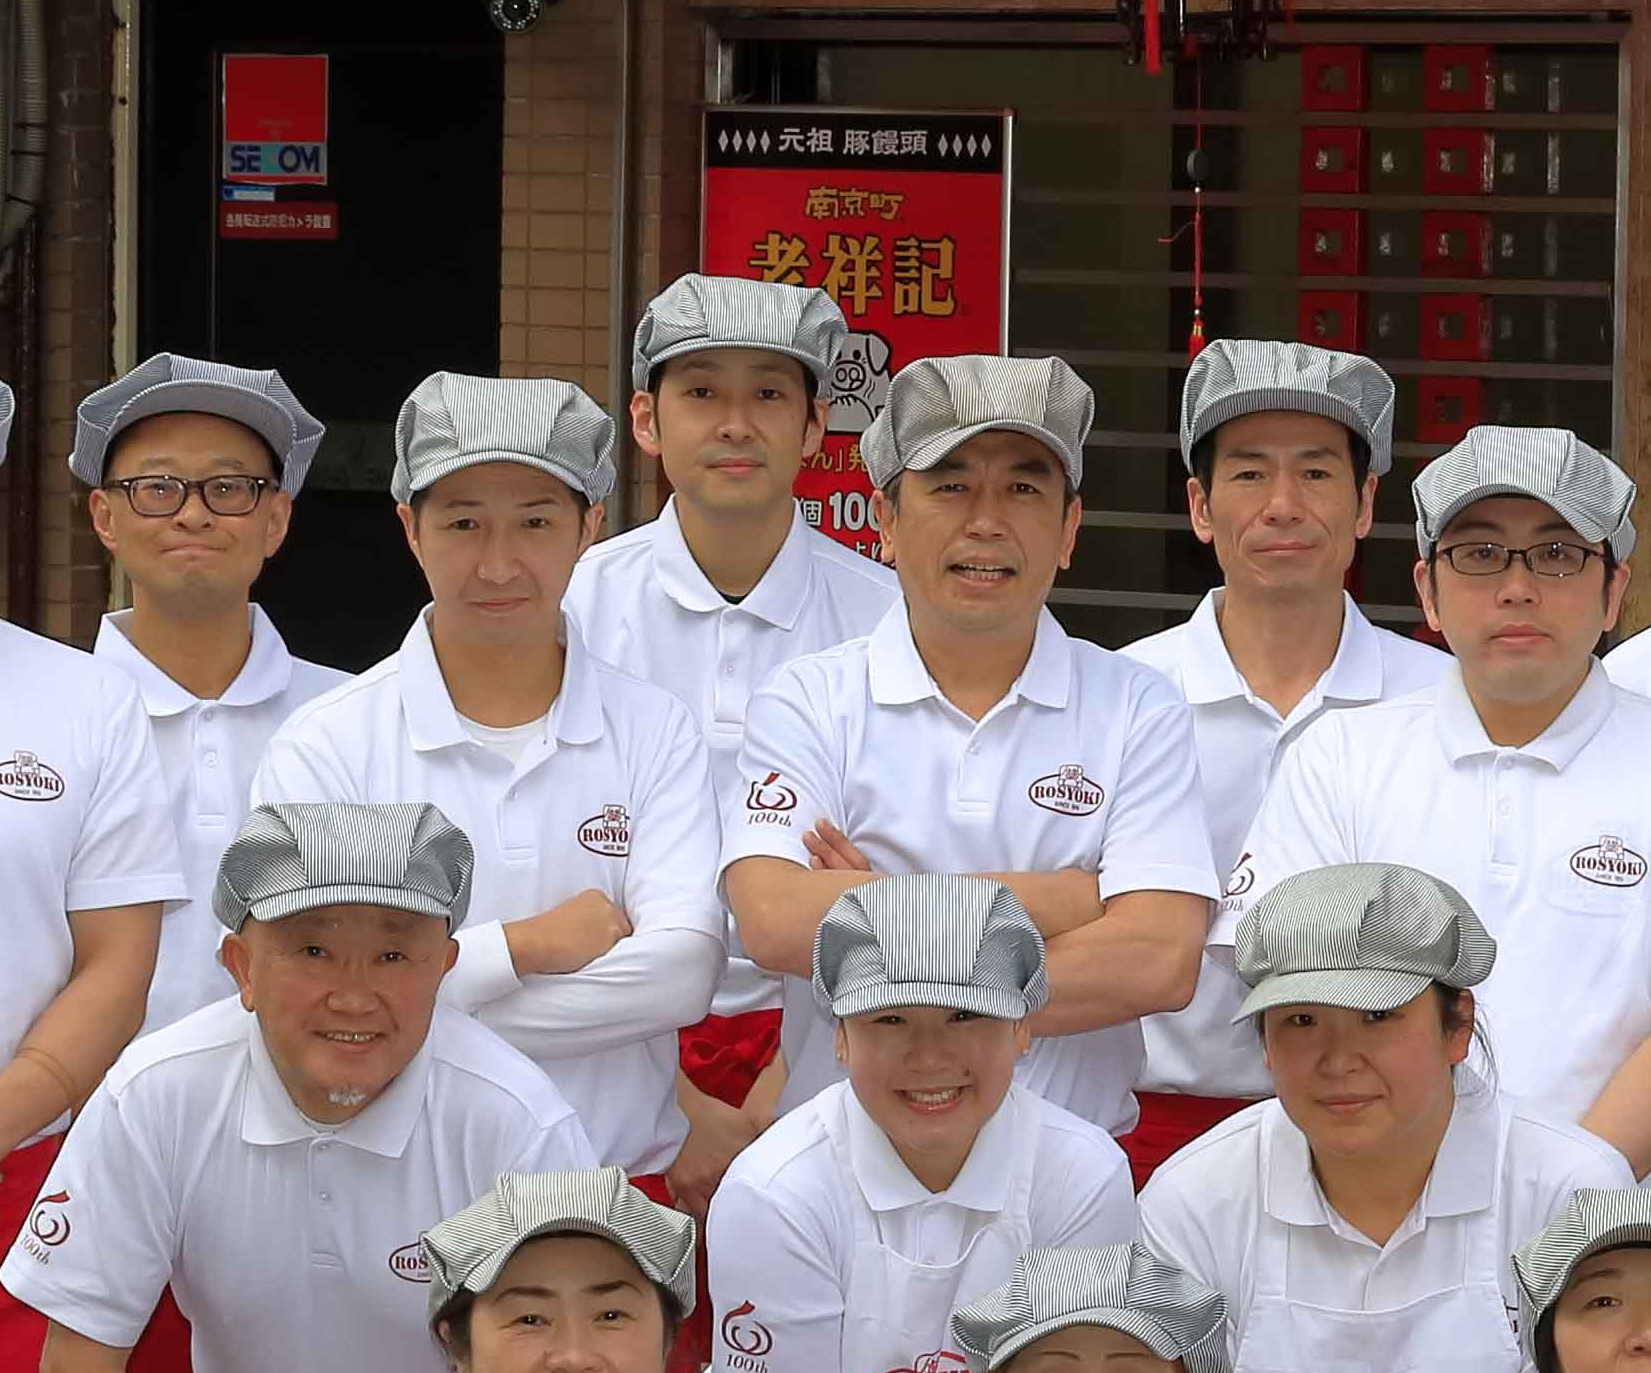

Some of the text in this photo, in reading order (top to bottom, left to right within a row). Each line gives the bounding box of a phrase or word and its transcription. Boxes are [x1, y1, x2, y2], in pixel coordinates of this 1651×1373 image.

[778, 127, 929, 156] 元祖 豚饅頭
[230, 144, 321, 174] SECOM
[805, 185, 905, 220] 南京町
[748, 231, 957, 317] 老祥記
[1034, 785, 1100, 805] ROSYOKI
[583, 828, 629, 843] ROSYO
[1576, 856, 1642, 876] ROSYOKI
